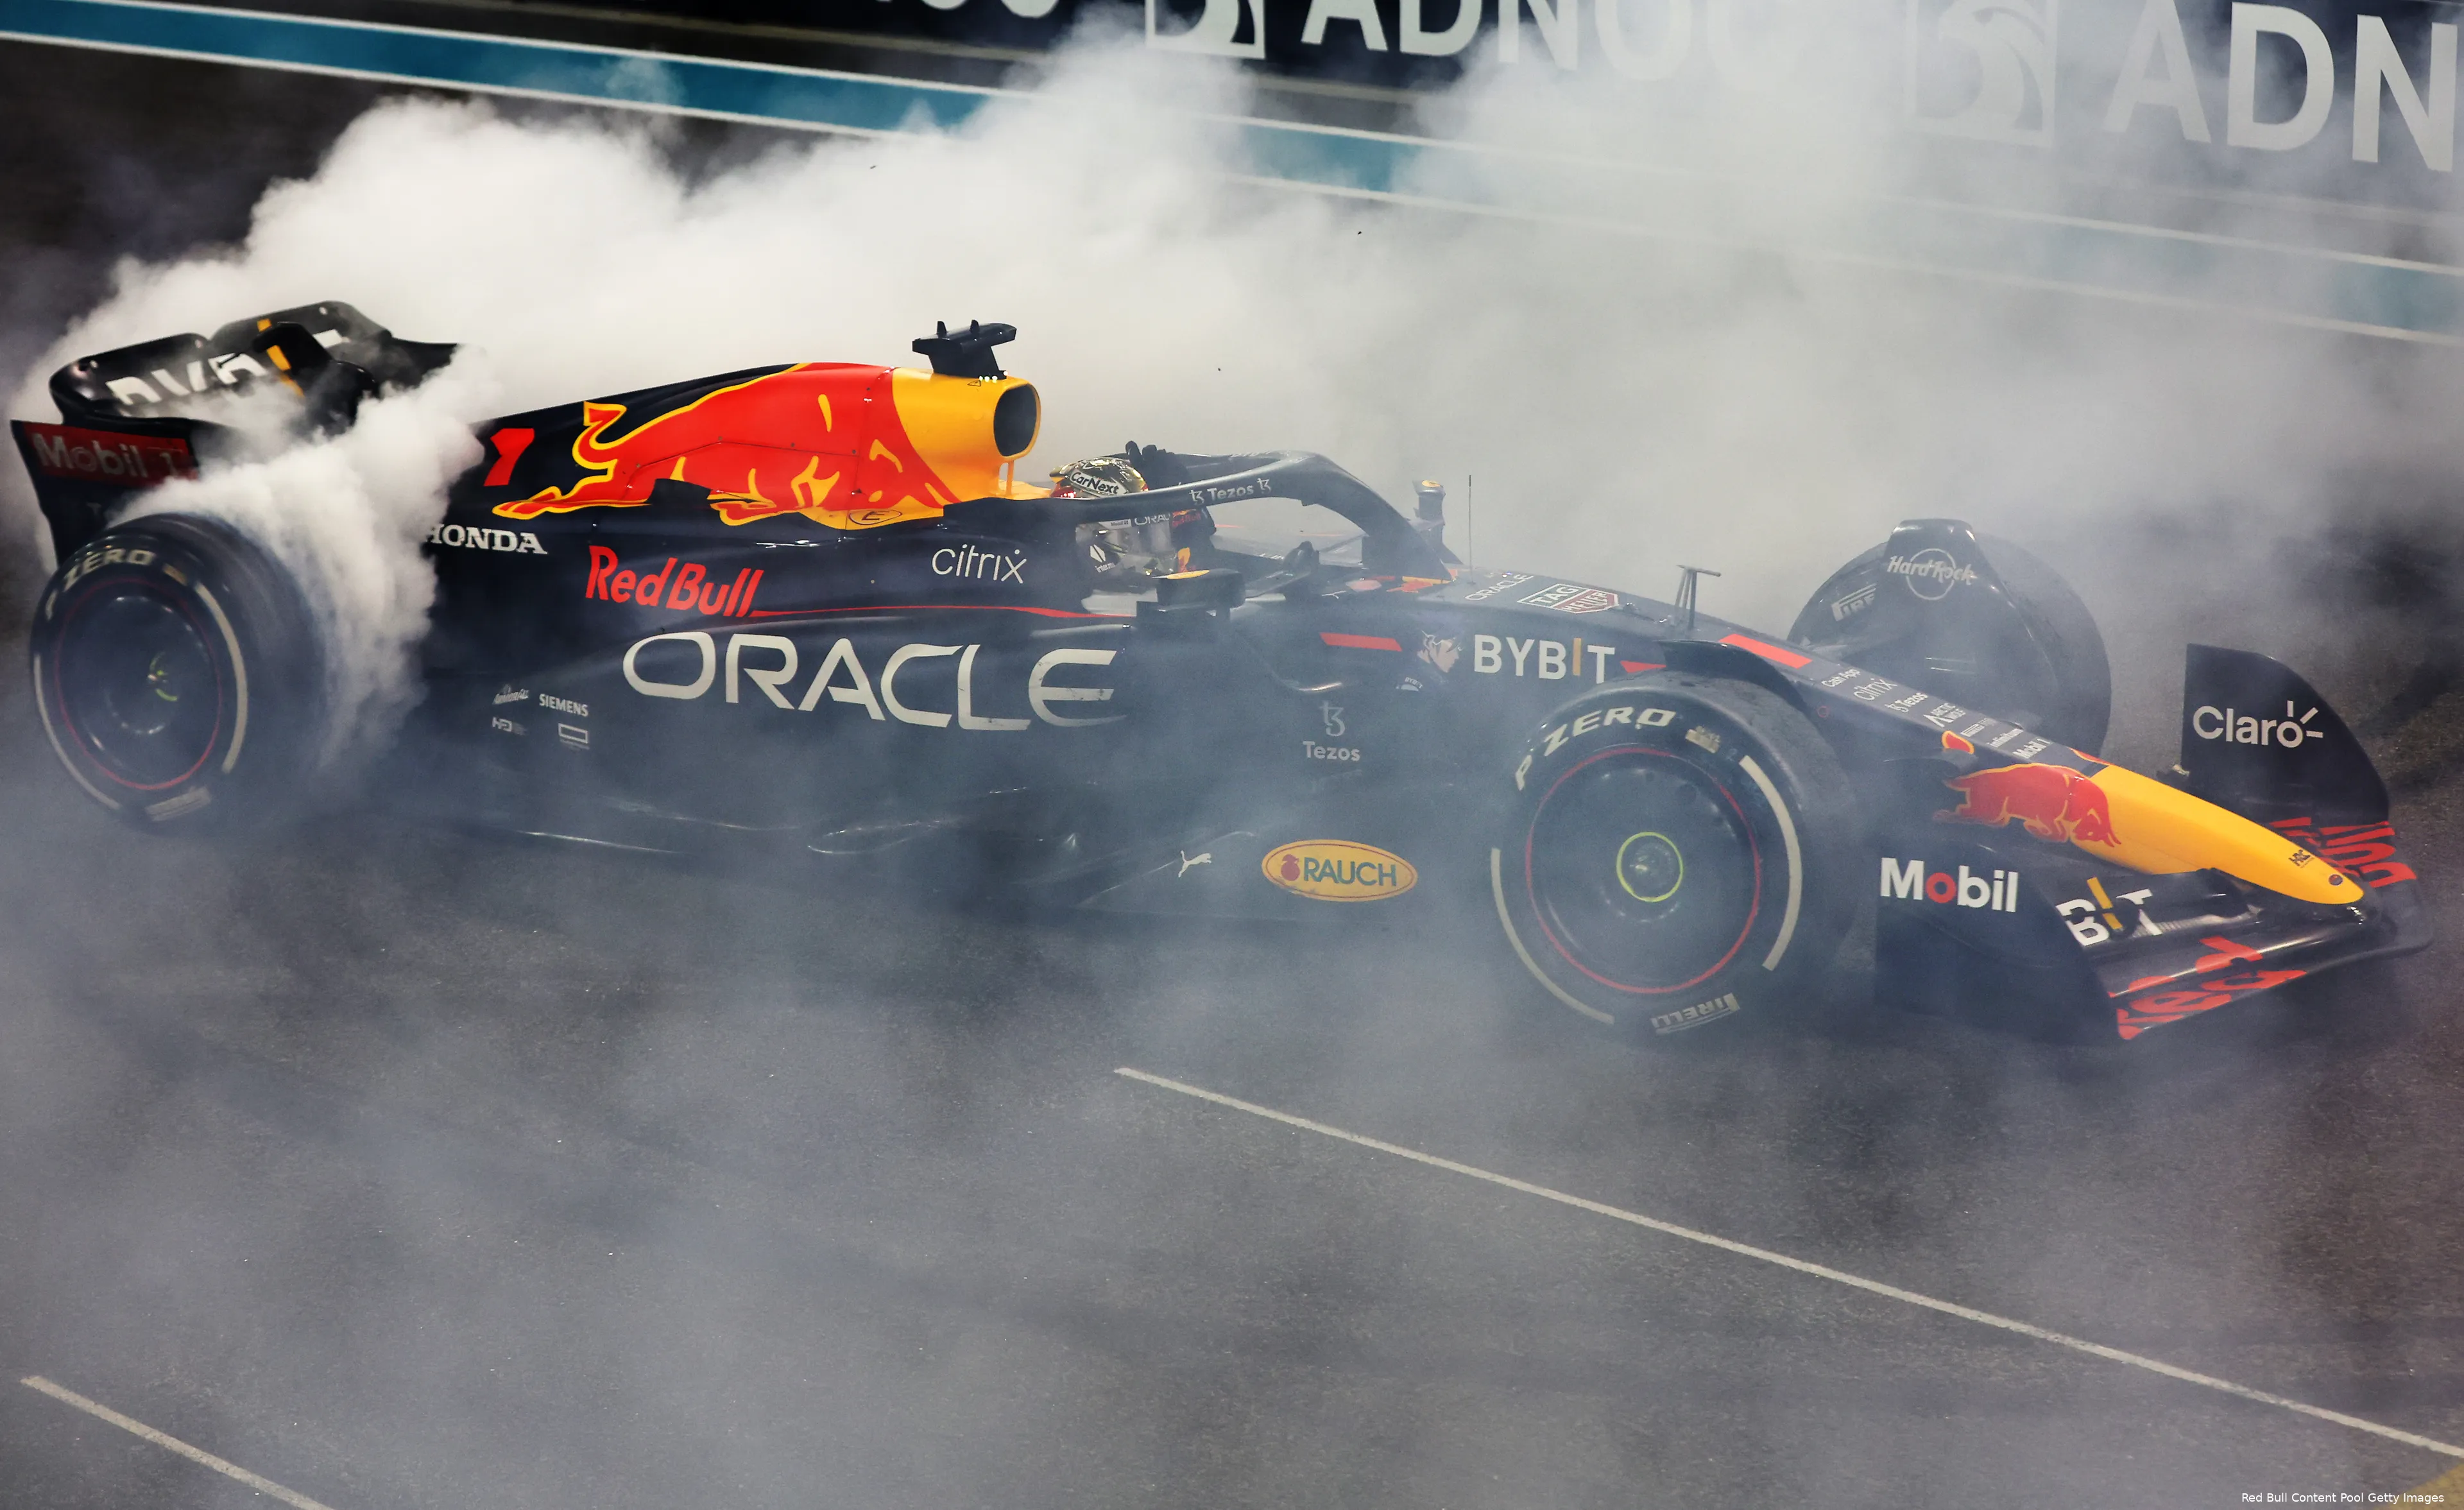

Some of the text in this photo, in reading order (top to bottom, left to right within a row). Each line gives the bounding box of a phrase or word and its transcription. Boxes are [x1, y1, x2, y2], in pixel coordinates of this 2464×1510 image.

[32, 432, 148, 477] Mobil
[484, 428, 535, 486] 1
[1071, 472, 1119, 494] CarNext
[1208, 484, 1254, 502] Tezos
[425, 523, 547, 555] HONDA
[62, 548, 157, 593] ZERO
[932, 544, 1027, 585] citrix
[1887, 555, 1978, 586] Hard Rock
[1465, 574, 1534, 601] ORACLE
[1530, 586, 1574, 605] TAG
[1562, 591, 1609, 612] HEUER
[1831, 583, 1877, 622] PIRE
[1474, 634, 1616, 684] BYBIT
[622, 631, 1127, 731] ORACLE
[1853, 678, 1898, 701] citrix
[539, 693, 589, 717] SIEMENS
[1894, 692, 1928, 708] Tezos
[2193, 705, 2304, 748] Claro
[1303, 740, 1360, 762] Tezos
[1515, 755, 1532, 791] P
[1543, 706, 1676, 757] ZERO
[2012, 740, 2047, 759] Mobil
[1303, 856, 1397, 887] RAUCH
[1879, 857, 2019, 913] Mobil
[1650, 993, 1741, 1035] PIRELLI
